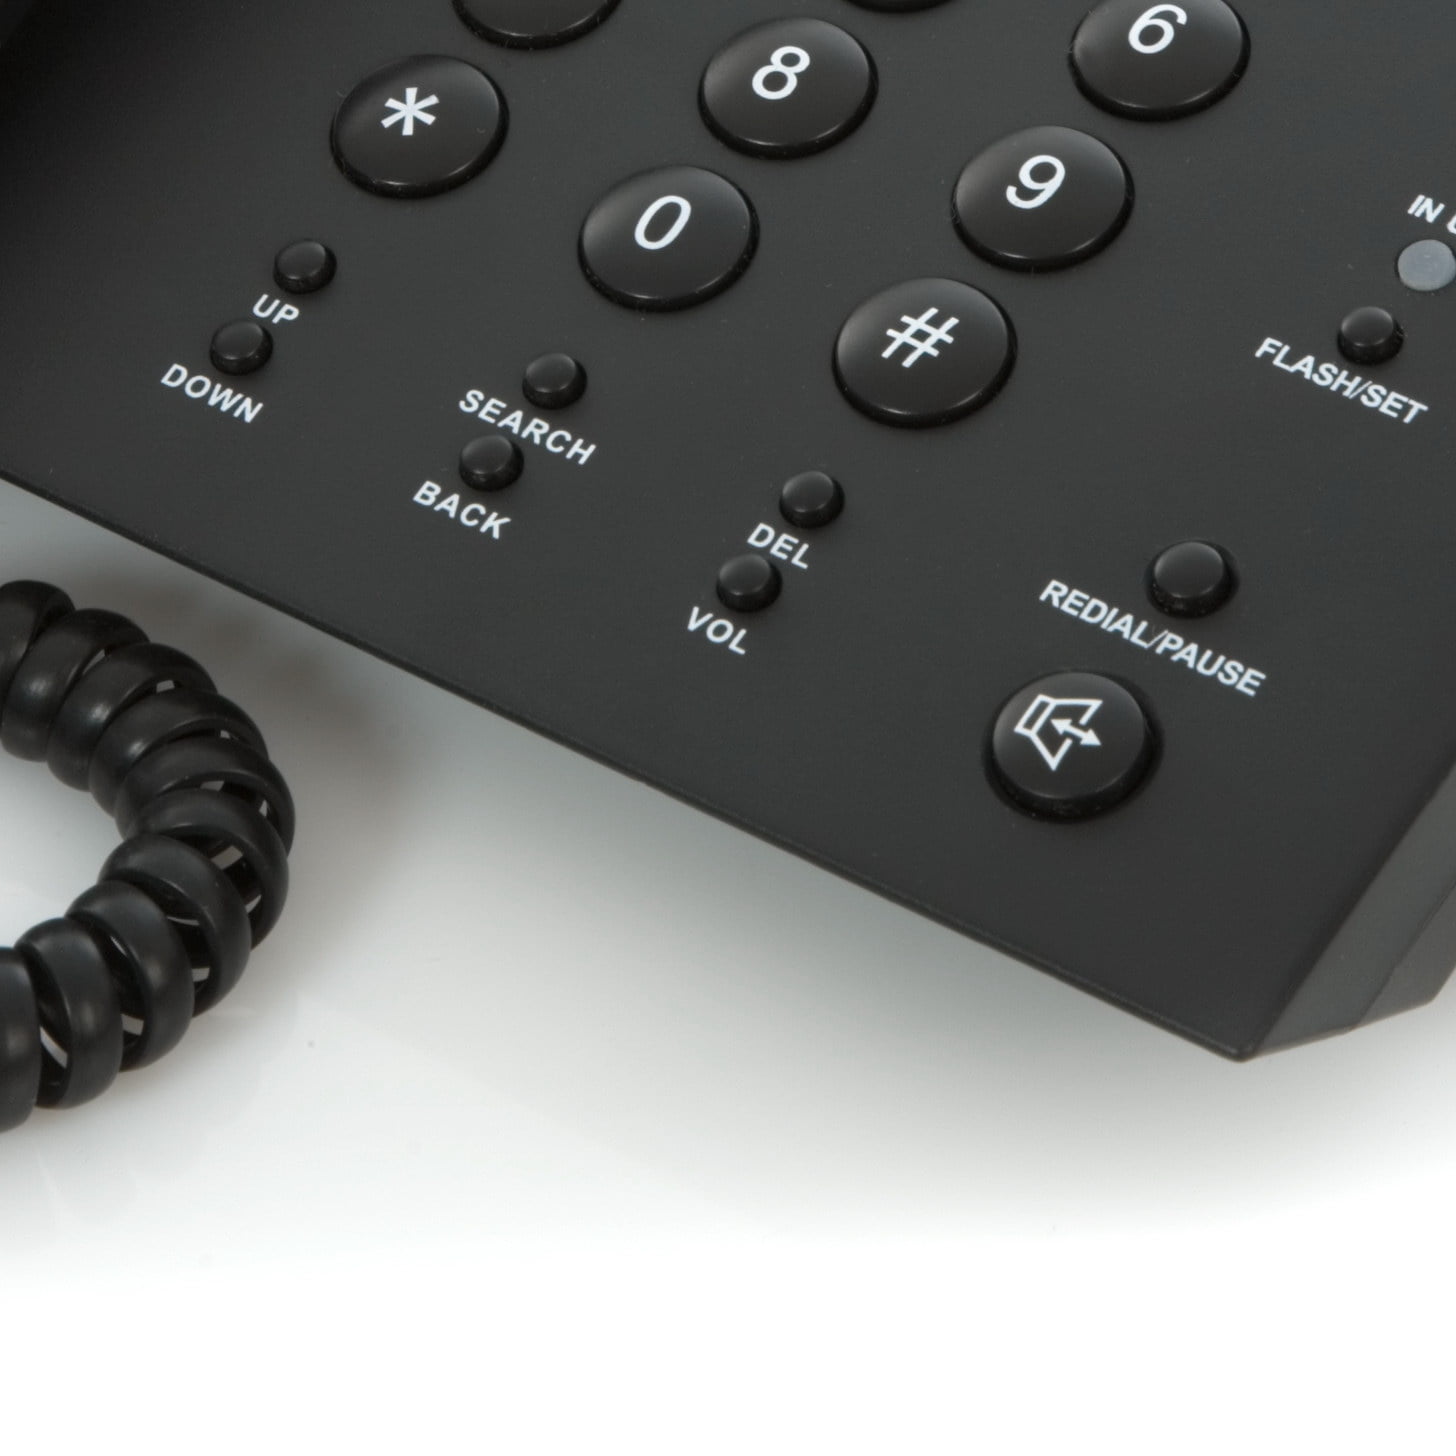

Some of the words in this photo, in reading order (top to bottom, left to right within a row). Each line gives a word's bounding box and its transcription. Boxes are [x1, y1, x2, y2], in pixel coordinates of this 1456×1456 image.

[1126, 2, 1189, 56] 6
[750, 44, 812, 102] 8
[1004, 153, 1067, 211] 9
[1406, 193, 1447, 225] IN
[633, 193, 693, 252] 0
[251, 292, 301, 328] UP
[880, 305, 961, 370] #
[159, 362, 265, 425] DOWN
[1253, 335, 1430, 427] FLASH/SET
[457, 388, 598, 467] SEARCH
[411, 479, 513, 541] BACK
[745, 521, 811, 571] DEL
[686, 604, 748, 656] VOL
[1037, 578, 1268, 698] REDIAL/PAUSE
